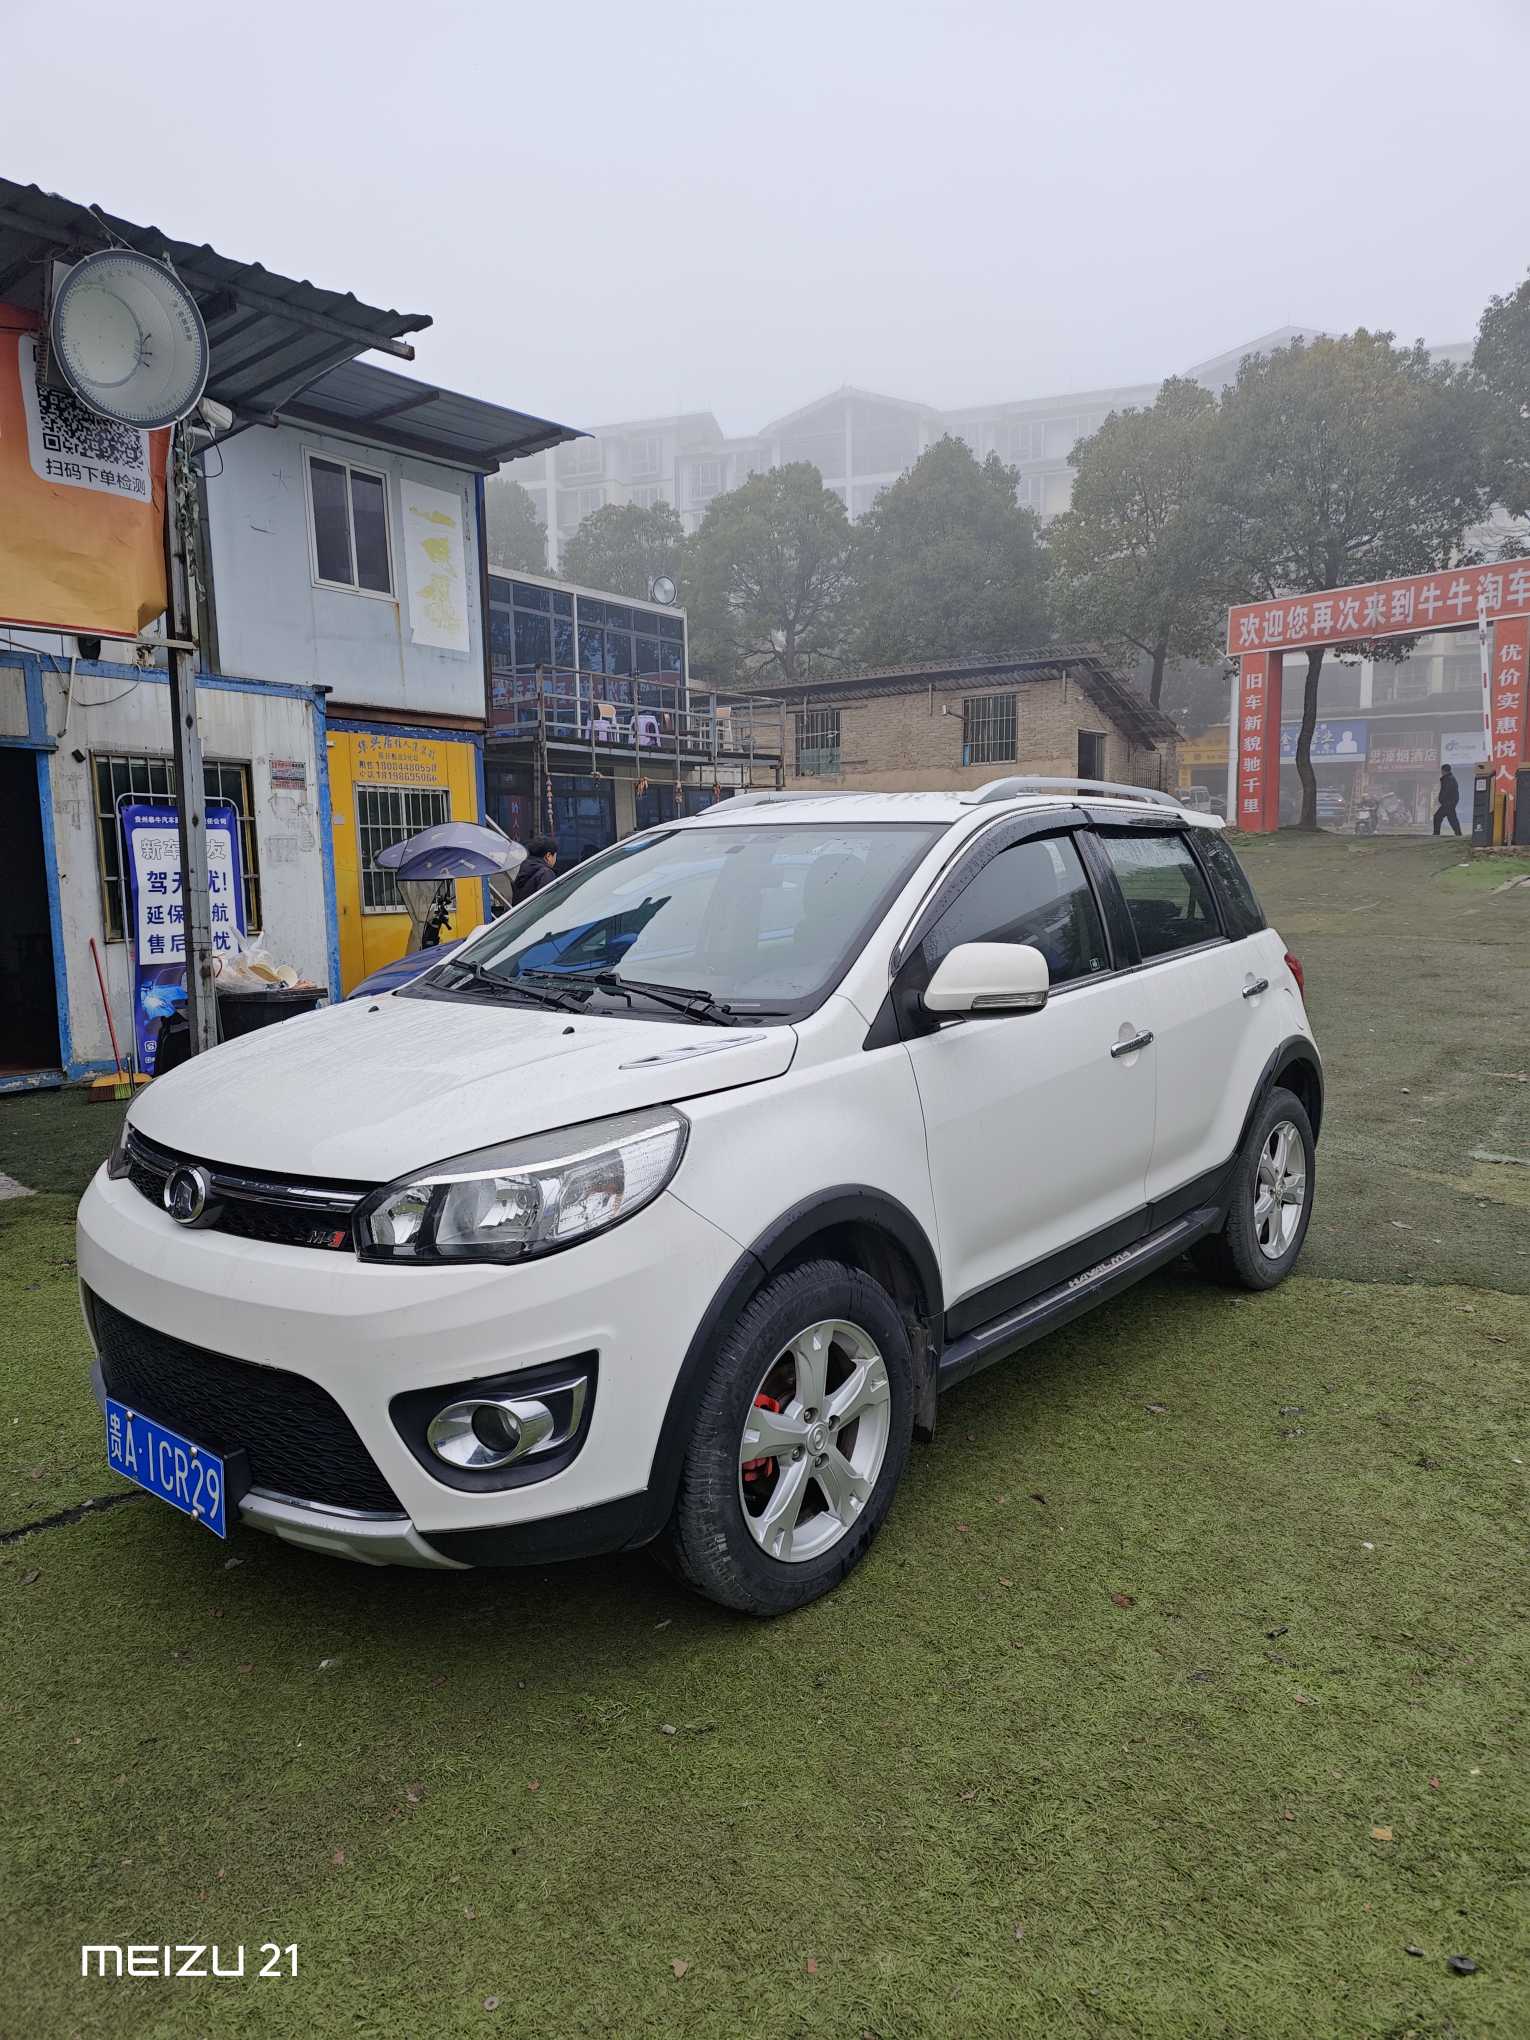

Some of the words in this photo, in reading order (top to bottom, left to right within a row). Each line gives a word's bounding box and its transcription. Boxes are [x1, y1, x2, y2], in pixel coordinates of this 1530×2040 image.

[45, 458, 146, 496] 扫码下单检测
[1239, 568, 1530, 646] 欢迎您再次来到牛牛淘车
[1241, 673, 1263, 813] 旧车新貌驰千里
[146, 903, 229, 925] 延保航
[147, 931, 231, 955] 售后忧
